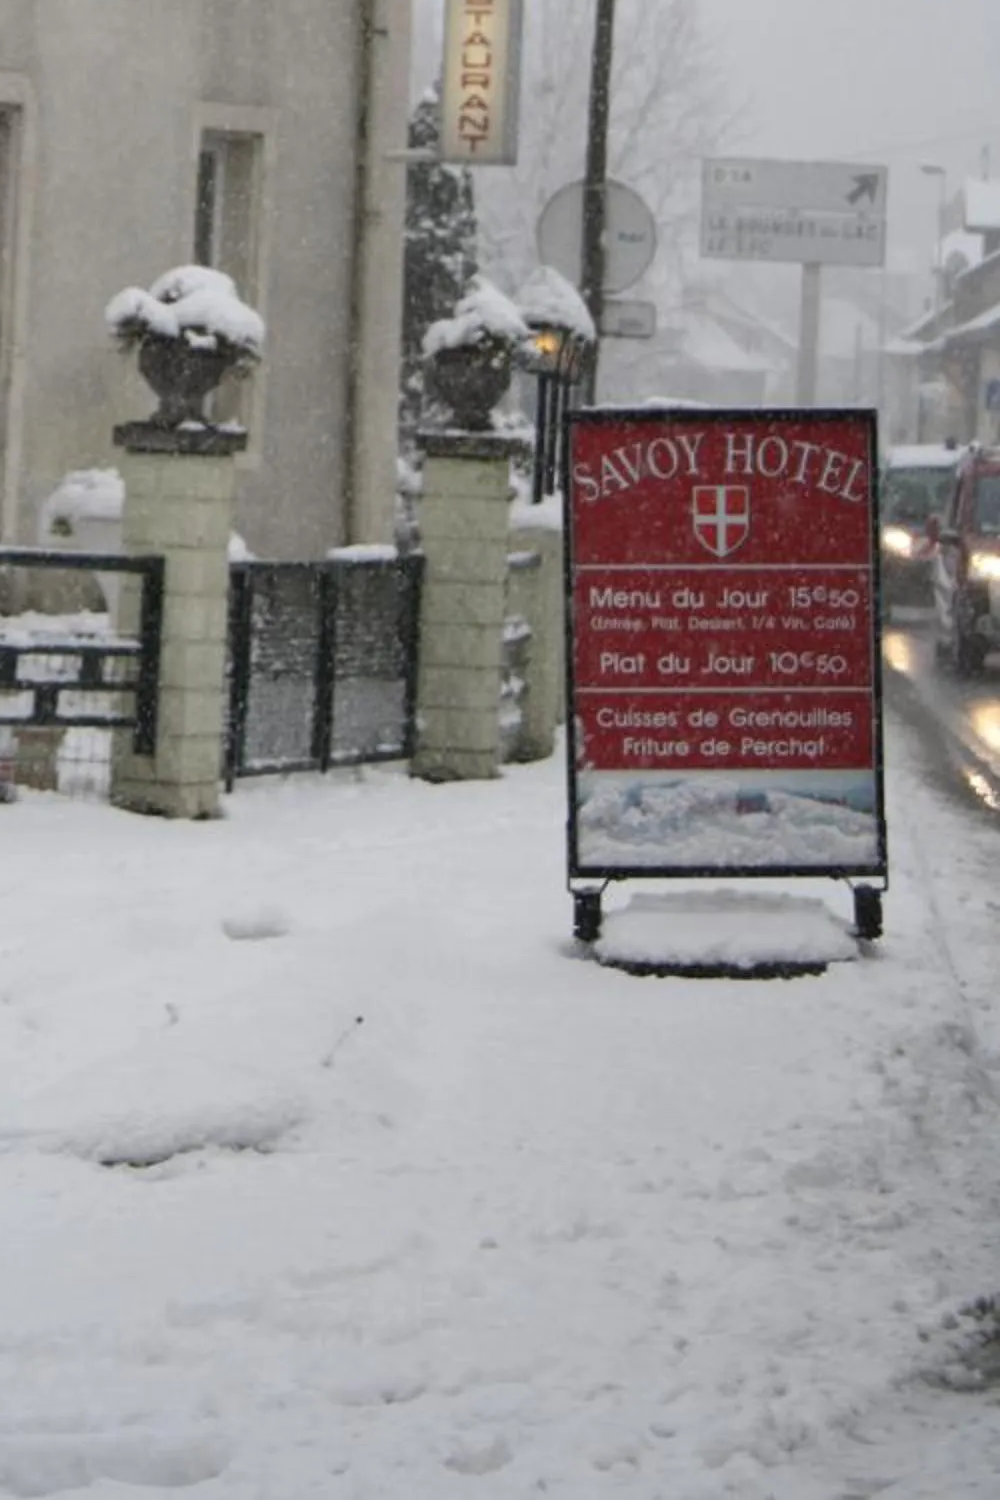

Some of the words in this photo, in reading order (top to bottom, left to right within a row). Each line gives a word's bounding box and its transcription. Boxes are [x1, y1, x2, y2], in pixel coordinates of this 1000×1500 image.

[572, 431, 705, 502] SAVOY
[722, 431, 867, 502] HOTEL
[589, 586, 661, 609] Menu
[672, 586, 705, 609] du
[716, 586, 769, 609] Jour
[600, 651, 646, 675] Plat
[657, 651, 691, 675] du
[701, 651, 755, 675] Jour
[596, 706, 679, 729] Cuisses
[687, 707, 719, 728] de
[728, 706, 853, 729] Grenouilles
[623, 736, 689, 756] Friture
[700, 736, 731, 756] de
